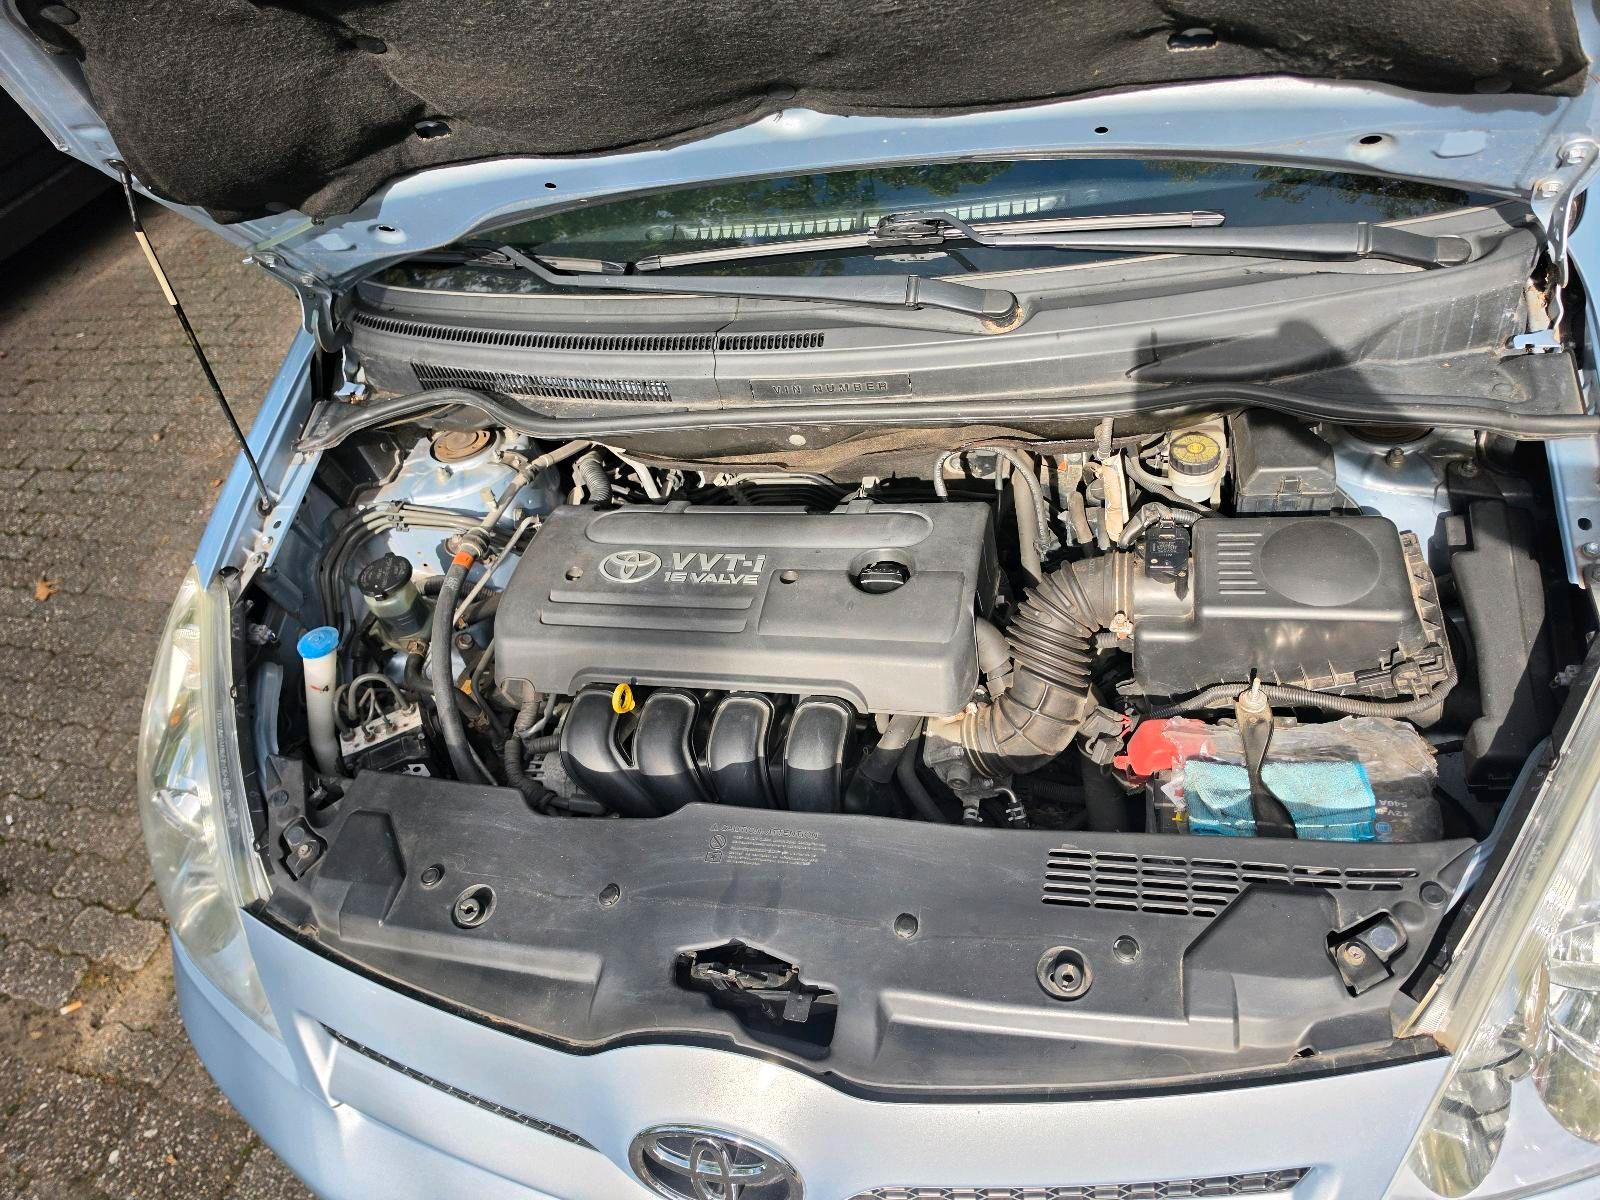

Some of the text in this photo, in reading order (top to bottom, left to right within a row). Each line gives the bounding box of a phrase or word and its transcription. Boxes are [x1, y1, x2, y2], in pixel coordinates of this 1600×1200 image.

[772, 382, 888, 394] VIN NUMBER
[664, 571, 760, 585] 16 VALVE
